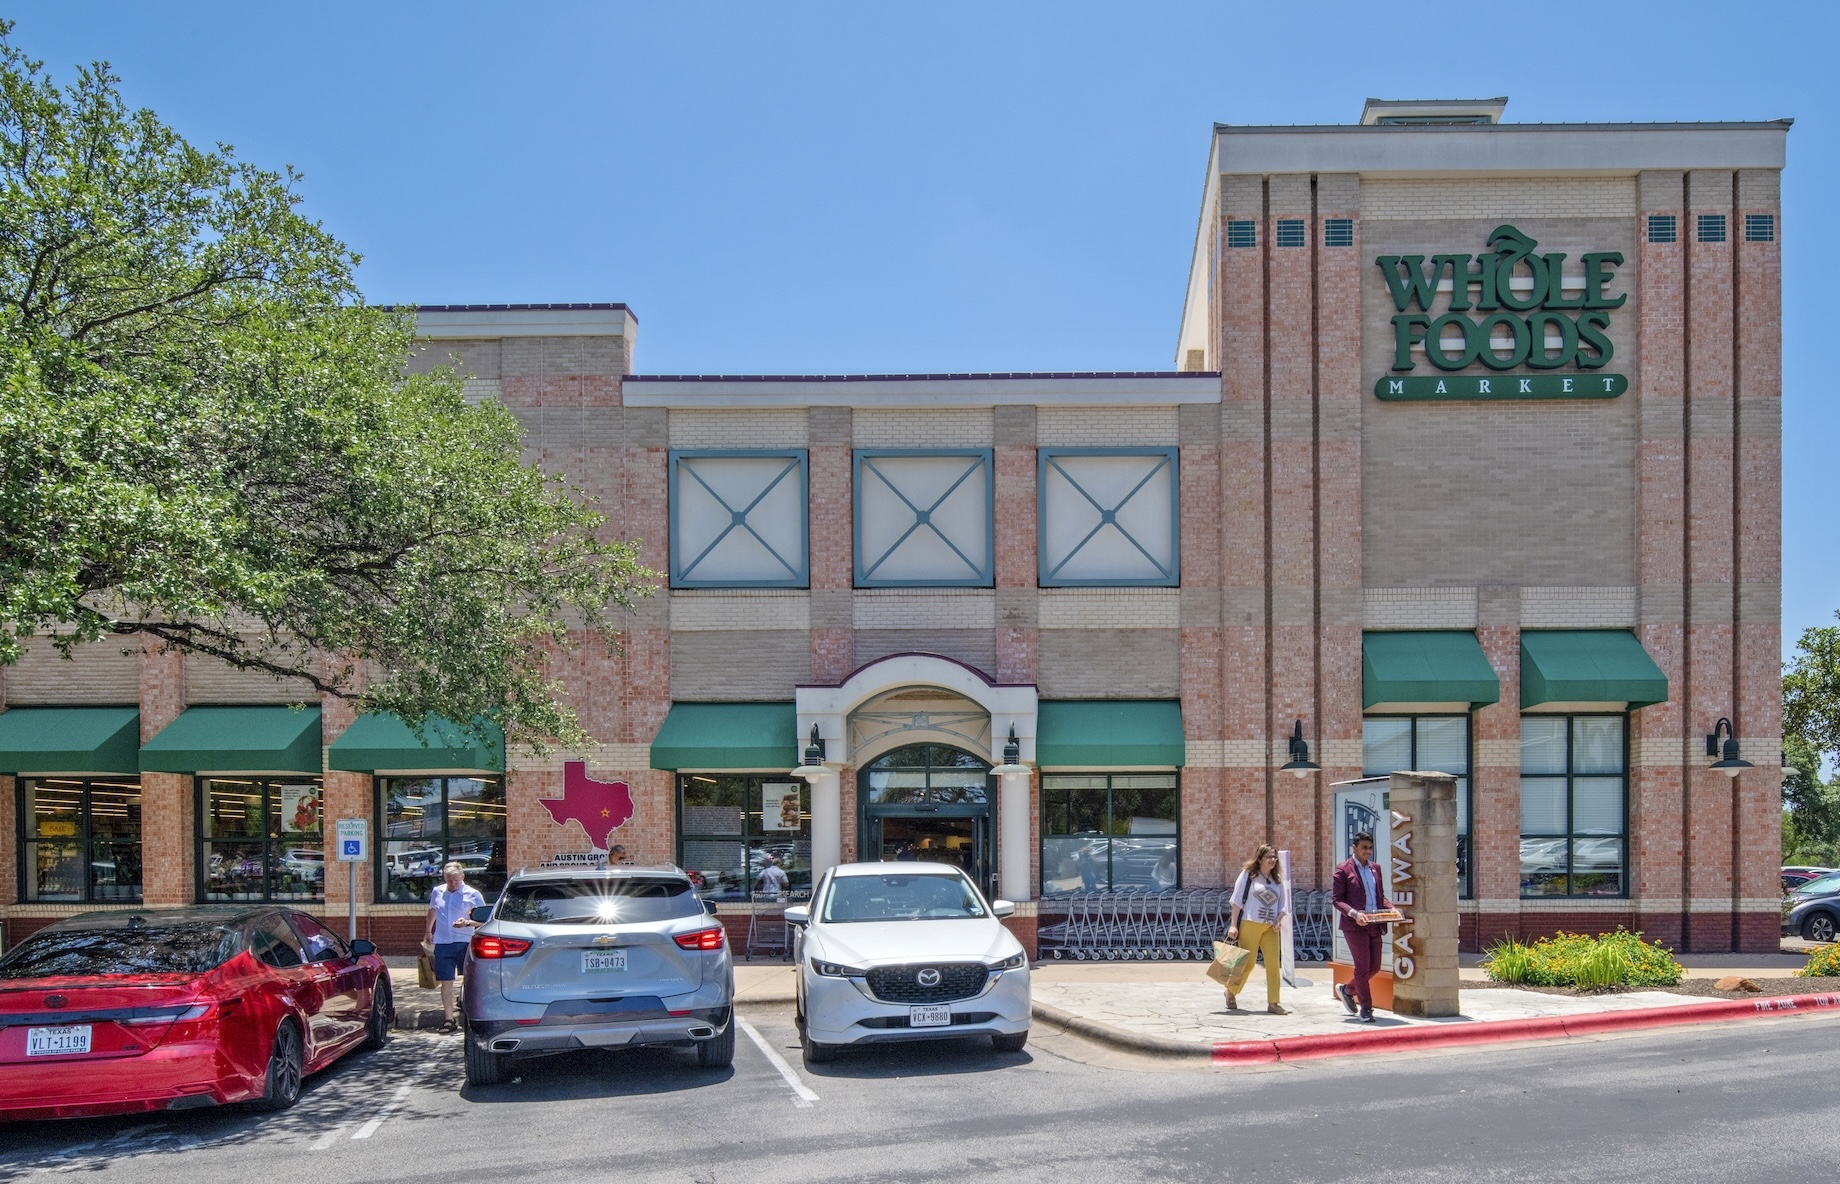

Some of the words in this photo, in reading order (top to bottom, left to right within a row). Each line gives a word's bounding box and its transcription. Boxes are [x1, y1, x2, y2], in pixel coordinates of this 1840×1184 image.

[1375, 249, 1627, 312] WHOLE
[1390, 311, 1614, 371] FOODS
[1389, 378, 1615, 394] MARKET
[587, 853, 608, 861] GRO
